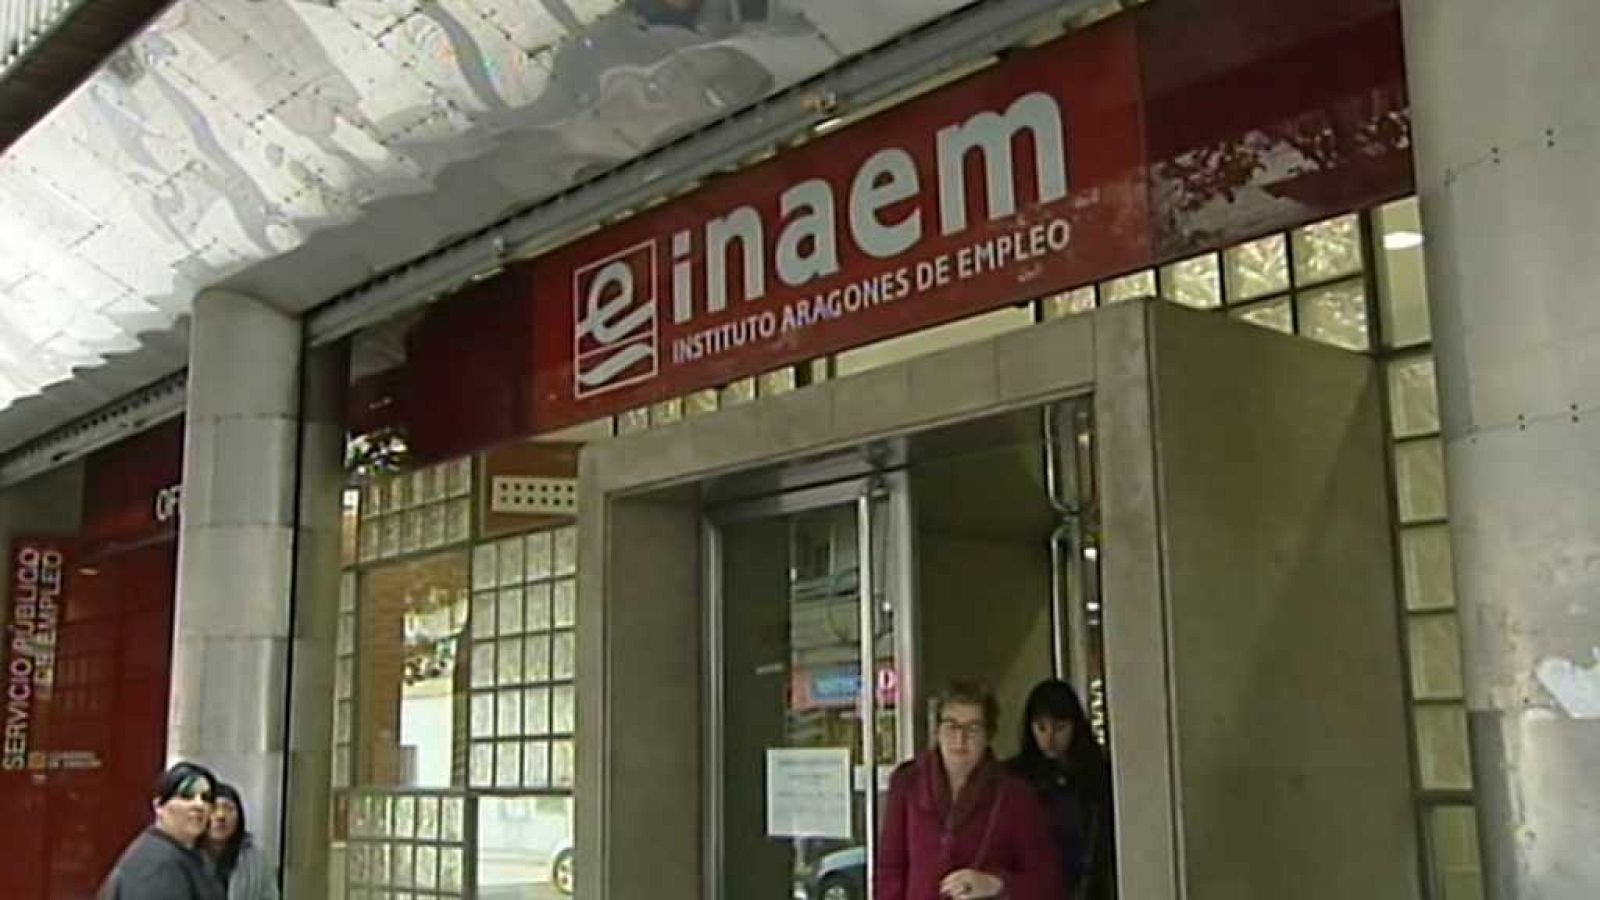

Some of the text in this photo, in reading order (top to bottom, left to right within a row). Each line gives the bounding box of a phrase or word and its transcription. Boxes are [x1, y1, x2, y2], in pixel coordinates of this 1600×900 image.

[672, 91, 1067, 326] inaem
[672, 219, 1071, 363] INSTITUTO ARAGONES DE EMPLEO
[3, 657, 32, 770] SERVICIO
